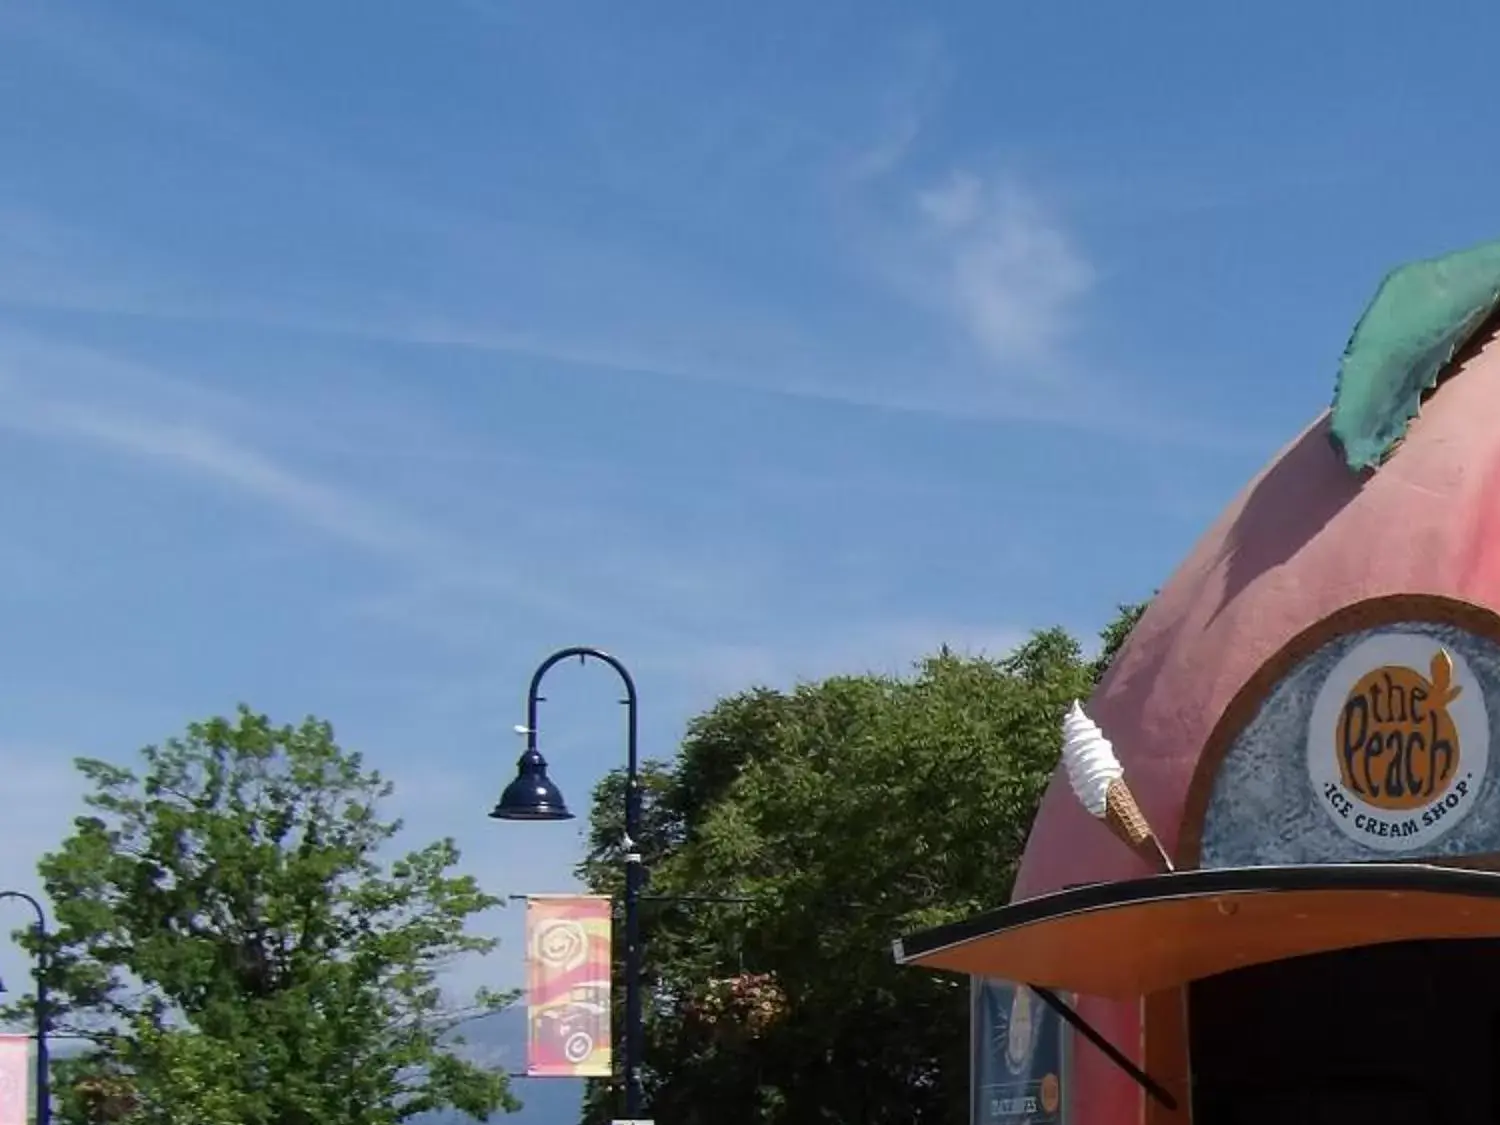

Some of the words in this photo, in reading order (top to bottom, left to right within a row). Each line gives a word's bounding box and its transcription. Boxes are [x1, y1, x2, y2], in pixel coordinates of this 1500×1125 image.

[1368, 673, 1428, 724] the
[1342, 693, 1453, 799] Peach
[1325, 784, 1353, 819] ICE
[1354, 814, 1419, 838] CREAM
[1421, 780, 1470, 827] SHOP
